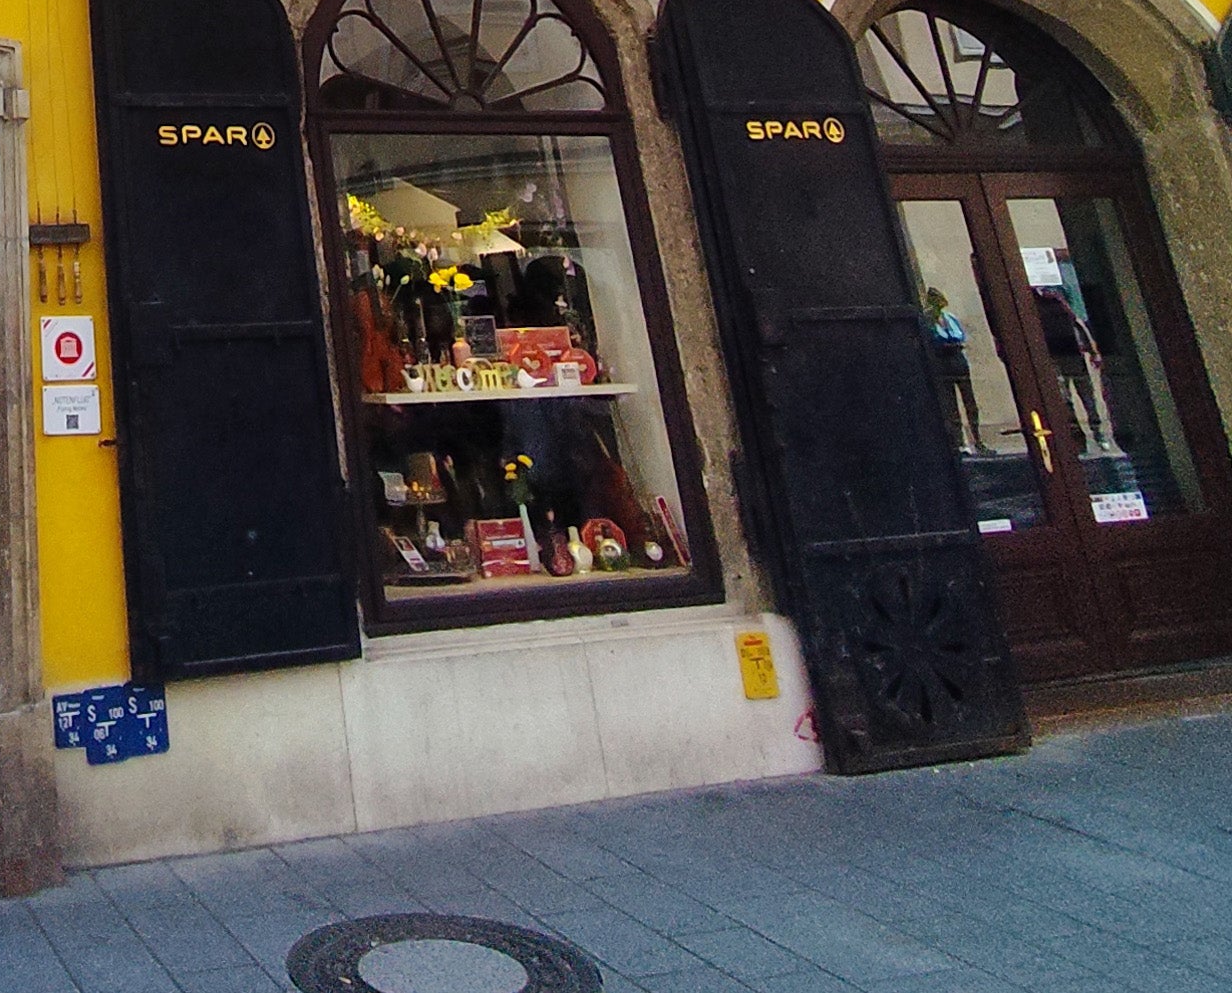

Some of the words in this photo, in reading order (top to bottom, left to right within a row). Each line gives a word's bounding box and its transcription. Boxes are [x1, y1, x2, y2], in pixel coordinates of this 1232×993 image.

[158, 125, 247, 146] SPAR
[746, 121, 822, 140] SPAR
[87, 705, 97, 723] S
[128, 696, 138, 714] S
